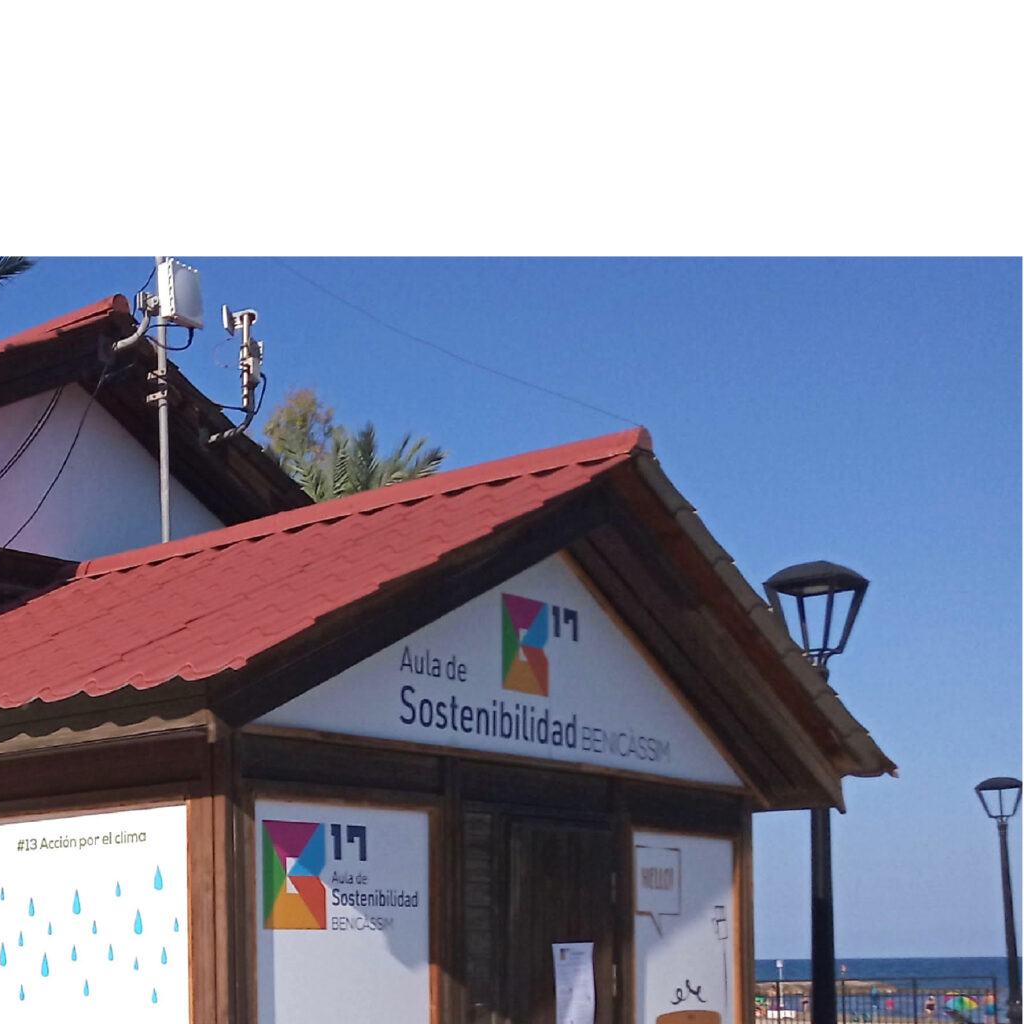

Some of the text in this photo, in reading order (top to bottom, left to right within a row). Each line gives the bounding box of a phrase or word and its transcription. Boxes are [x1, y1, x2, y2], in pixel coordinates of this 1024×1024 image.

[552, 605, 578, 642] 17
[400, 645, 467, 682] Aula de
[399, 685, 577, 749] Sostenibilidad
[17, 830, 147, 851] #13 Acción por el clima
[330, 823, 367, 861] 17
[332, 871, 368, 885] Aula de
[332, 888, 418, 907] Sostenibilidad
